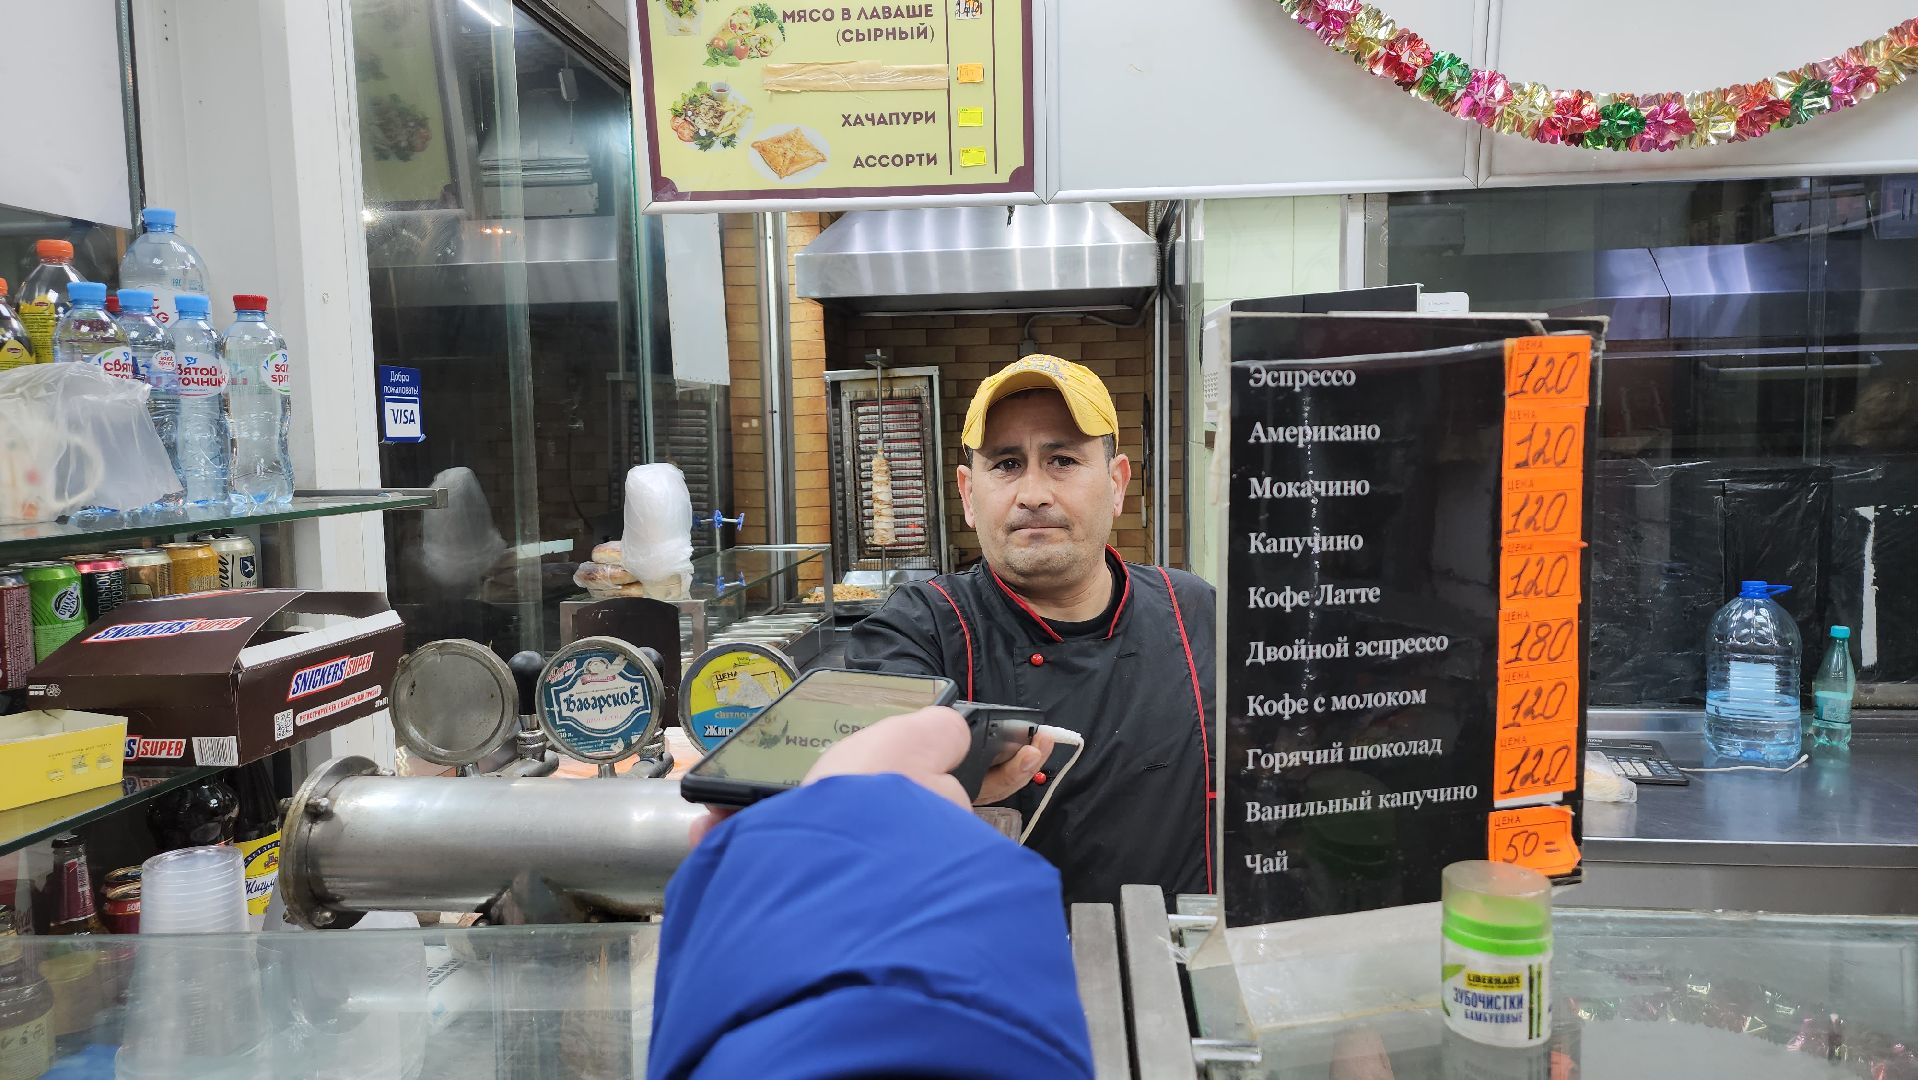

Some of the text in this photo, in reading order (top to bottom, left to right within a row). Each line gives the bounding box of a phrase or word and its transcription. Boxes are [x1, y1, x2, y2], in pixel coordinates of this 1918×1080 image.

[782, 4, 934, 23] МЯСО В ЛАВАШЕ
[836, 23, 935, 46] (СЫРНЫЙ)
[841, 111, 936, 127] ХАЧАПУРИ
[852, 153, 938, 168] АССОРТИ
[1518, 339, 1544, 350] ЦЕНА
[390, 371, 410, 383] Добро
[1248, 366, 1357, 391] Эспрессо
[1508, 351, 1580, 398] 120
[383, 386, 419, 395] пожаловать!
[390, 409, 416, 424] VISA
[1510, 409, 1538, 420] ЦЕНА
[1248, 421, 1381, 448] Американо
[1514, 421, 1575, 468] 120
[1248, 476, 1370, 499] Мокачино
[1507, 480, 1534, 490] ЦЕНА
[1505, 491, 1568, 536] 120
[1248, 533, 1364, 558] Капучино
[1505, 553, 1570, 599] 120
[1247, 584, 1381, 612] Кофе Латте
[1504, 611, 1530, 622] ЦЕНА
[93, 617, 251, 640] SNICKERS SUPER
[1245, 636, 1449, 667] Двойной эспрессо
[1504, 620, 1574, 665] 180
[291, 654, 373, 695] SNICKERS SUPER
[1504, 672, 1530, 683] ЦЕНА
[1246, 689, 1427, 720] Кофе с молоком
[1502, 680, 1567, 729] 120
[141, 740, 184, 757] SUPER
[1501, 735, 1527, 747] ЦЕНА
[1246, 738, 1443, 774] Горячий шоколад
[1502, 744, 1571, 794] 120
[1245, 784, 1478, 823] Ванильный капучино
[1494, 816, 1521, 826] ЦЕНА
[1245, 851, 1289, 875] Чай
[1453, 987, 1524, 1010] ЗУБОЧИСТКИ
[1465, 1011, 1522, 1023] БАМБУКОВЫЕ
